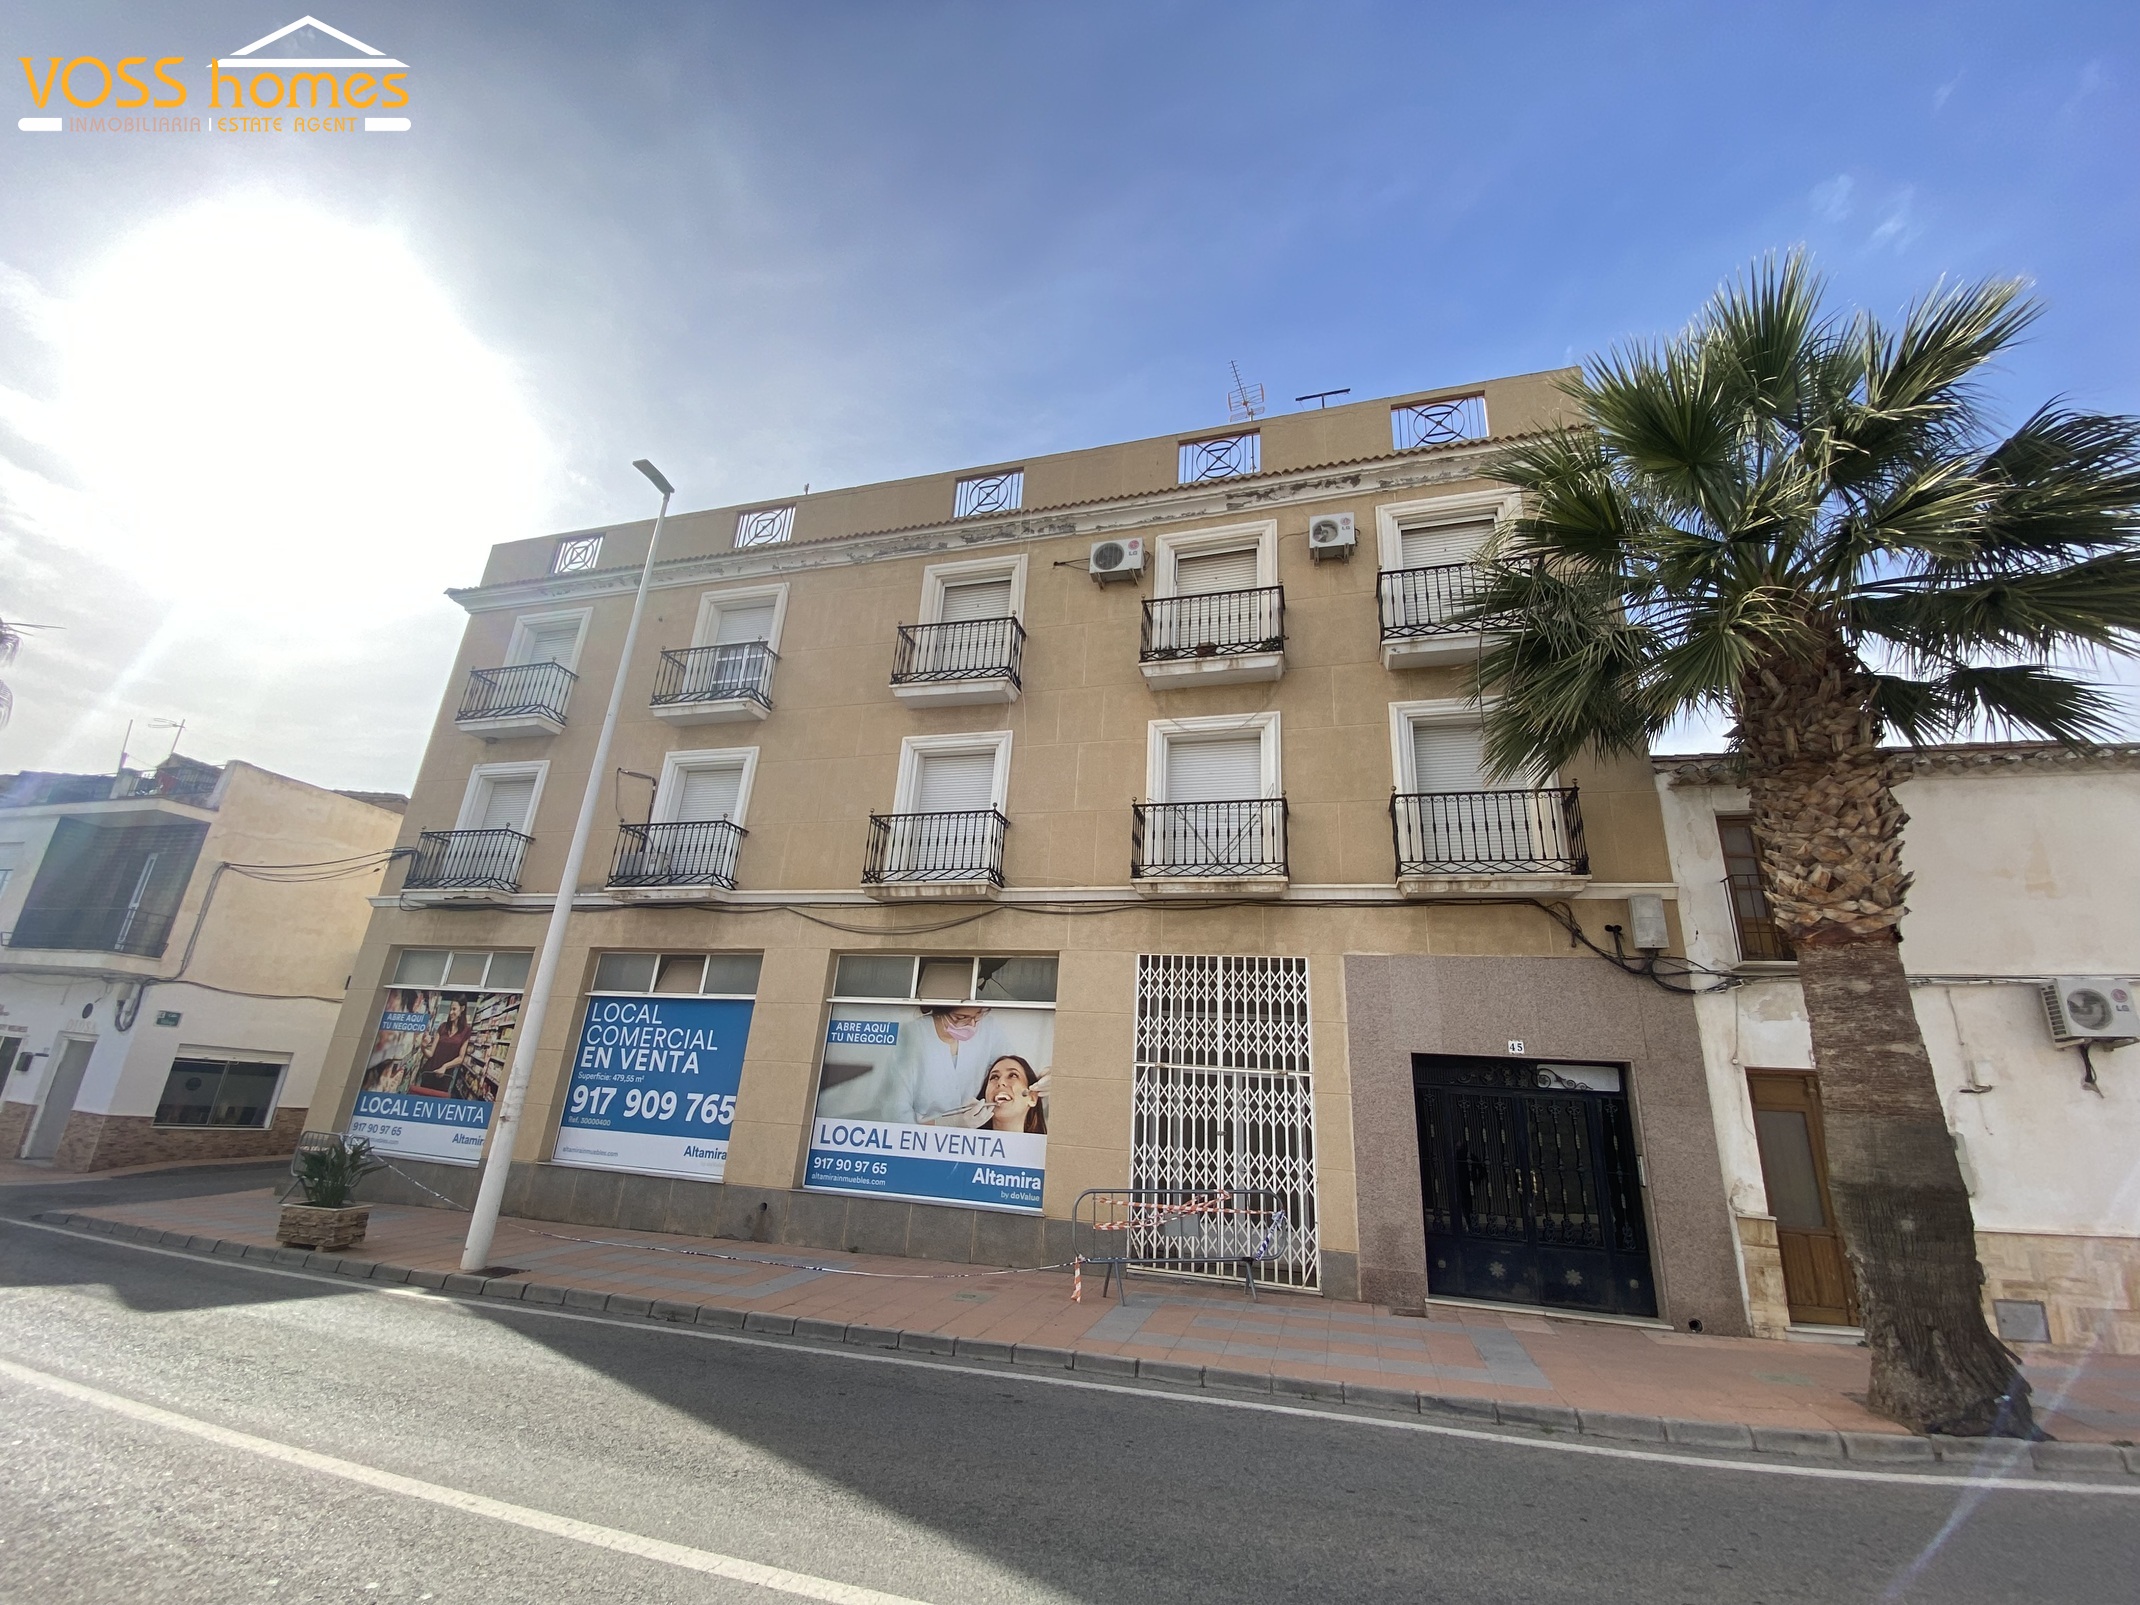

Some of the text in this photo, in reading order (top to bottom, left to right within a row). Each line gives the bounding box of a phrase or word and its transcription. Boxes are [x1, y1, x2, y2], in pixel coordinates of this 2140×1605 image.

[591, 1002, 663, 1024] LOCAL
[2115, 1004, 2130, 1012] LG
[386, 1013, 405, 1021] ABRE
[382, 1021, 426, 1032] TU NEGOCIO
[835, 1022, 891, 1033] ABRE AQUÍ
[586, 1024, 719, 1051] COMERCIAL
[831, 1032, 895, 1044] TU NEGOCIO
[1509, 1042, 1524, 1052] 45
[580, 1046, 700, 1075] EN VENTA
[577, 1071, 612, 1082] Superficie:
[360, 1096, 484, 1124] LOCAL EN VENTA
[570, 1084, 738, 1126] 917 909 765
[568, 1115, 579, 1124] Ref.
[352, 1121, 402, 1137] 917 90 97 65
[451, 1133, 485, 1146] Altamir
[820, 1124, 1006, 1159] LOCAL EN VENTA
[683, 1145, 727, 1161] Altamira
[813, 1156, 888, 1175] 917 90 97 65
[811, 1172, 886, 1186] altamirainmuebles.com
[971, 1167, 1041, 1190] Altamira
[1000, 1190, 1040, 1202] by doValue
